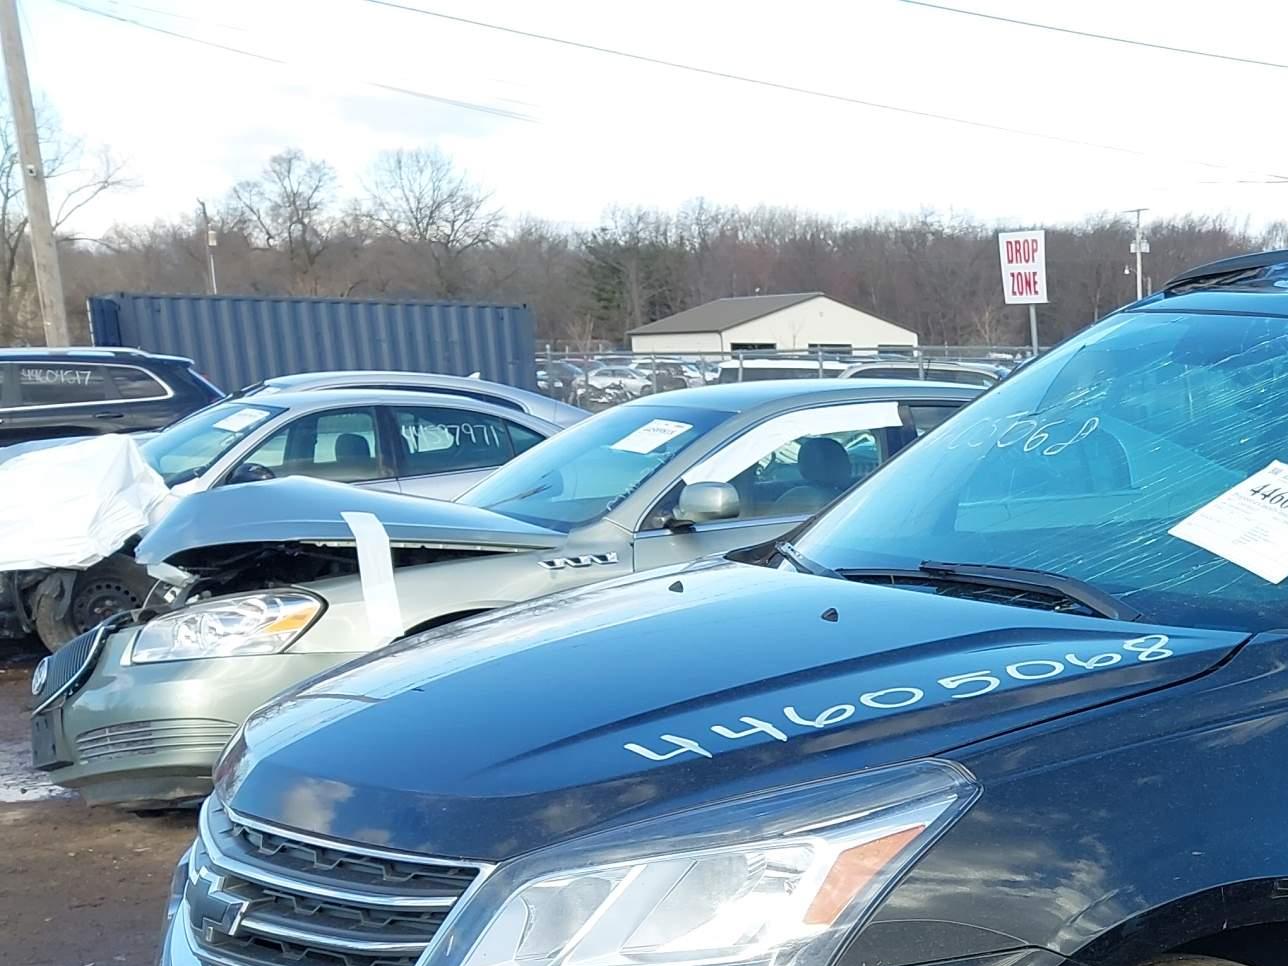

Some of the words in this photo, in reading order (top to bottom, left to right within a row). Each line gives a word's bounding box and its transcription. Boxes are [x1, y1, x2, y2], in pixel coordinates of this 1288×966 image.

[1006, 239, 1039, 264] DROP
[1010, 271, 1039, 296] ZONE
[623, 634, 1175, 761] 44605068
